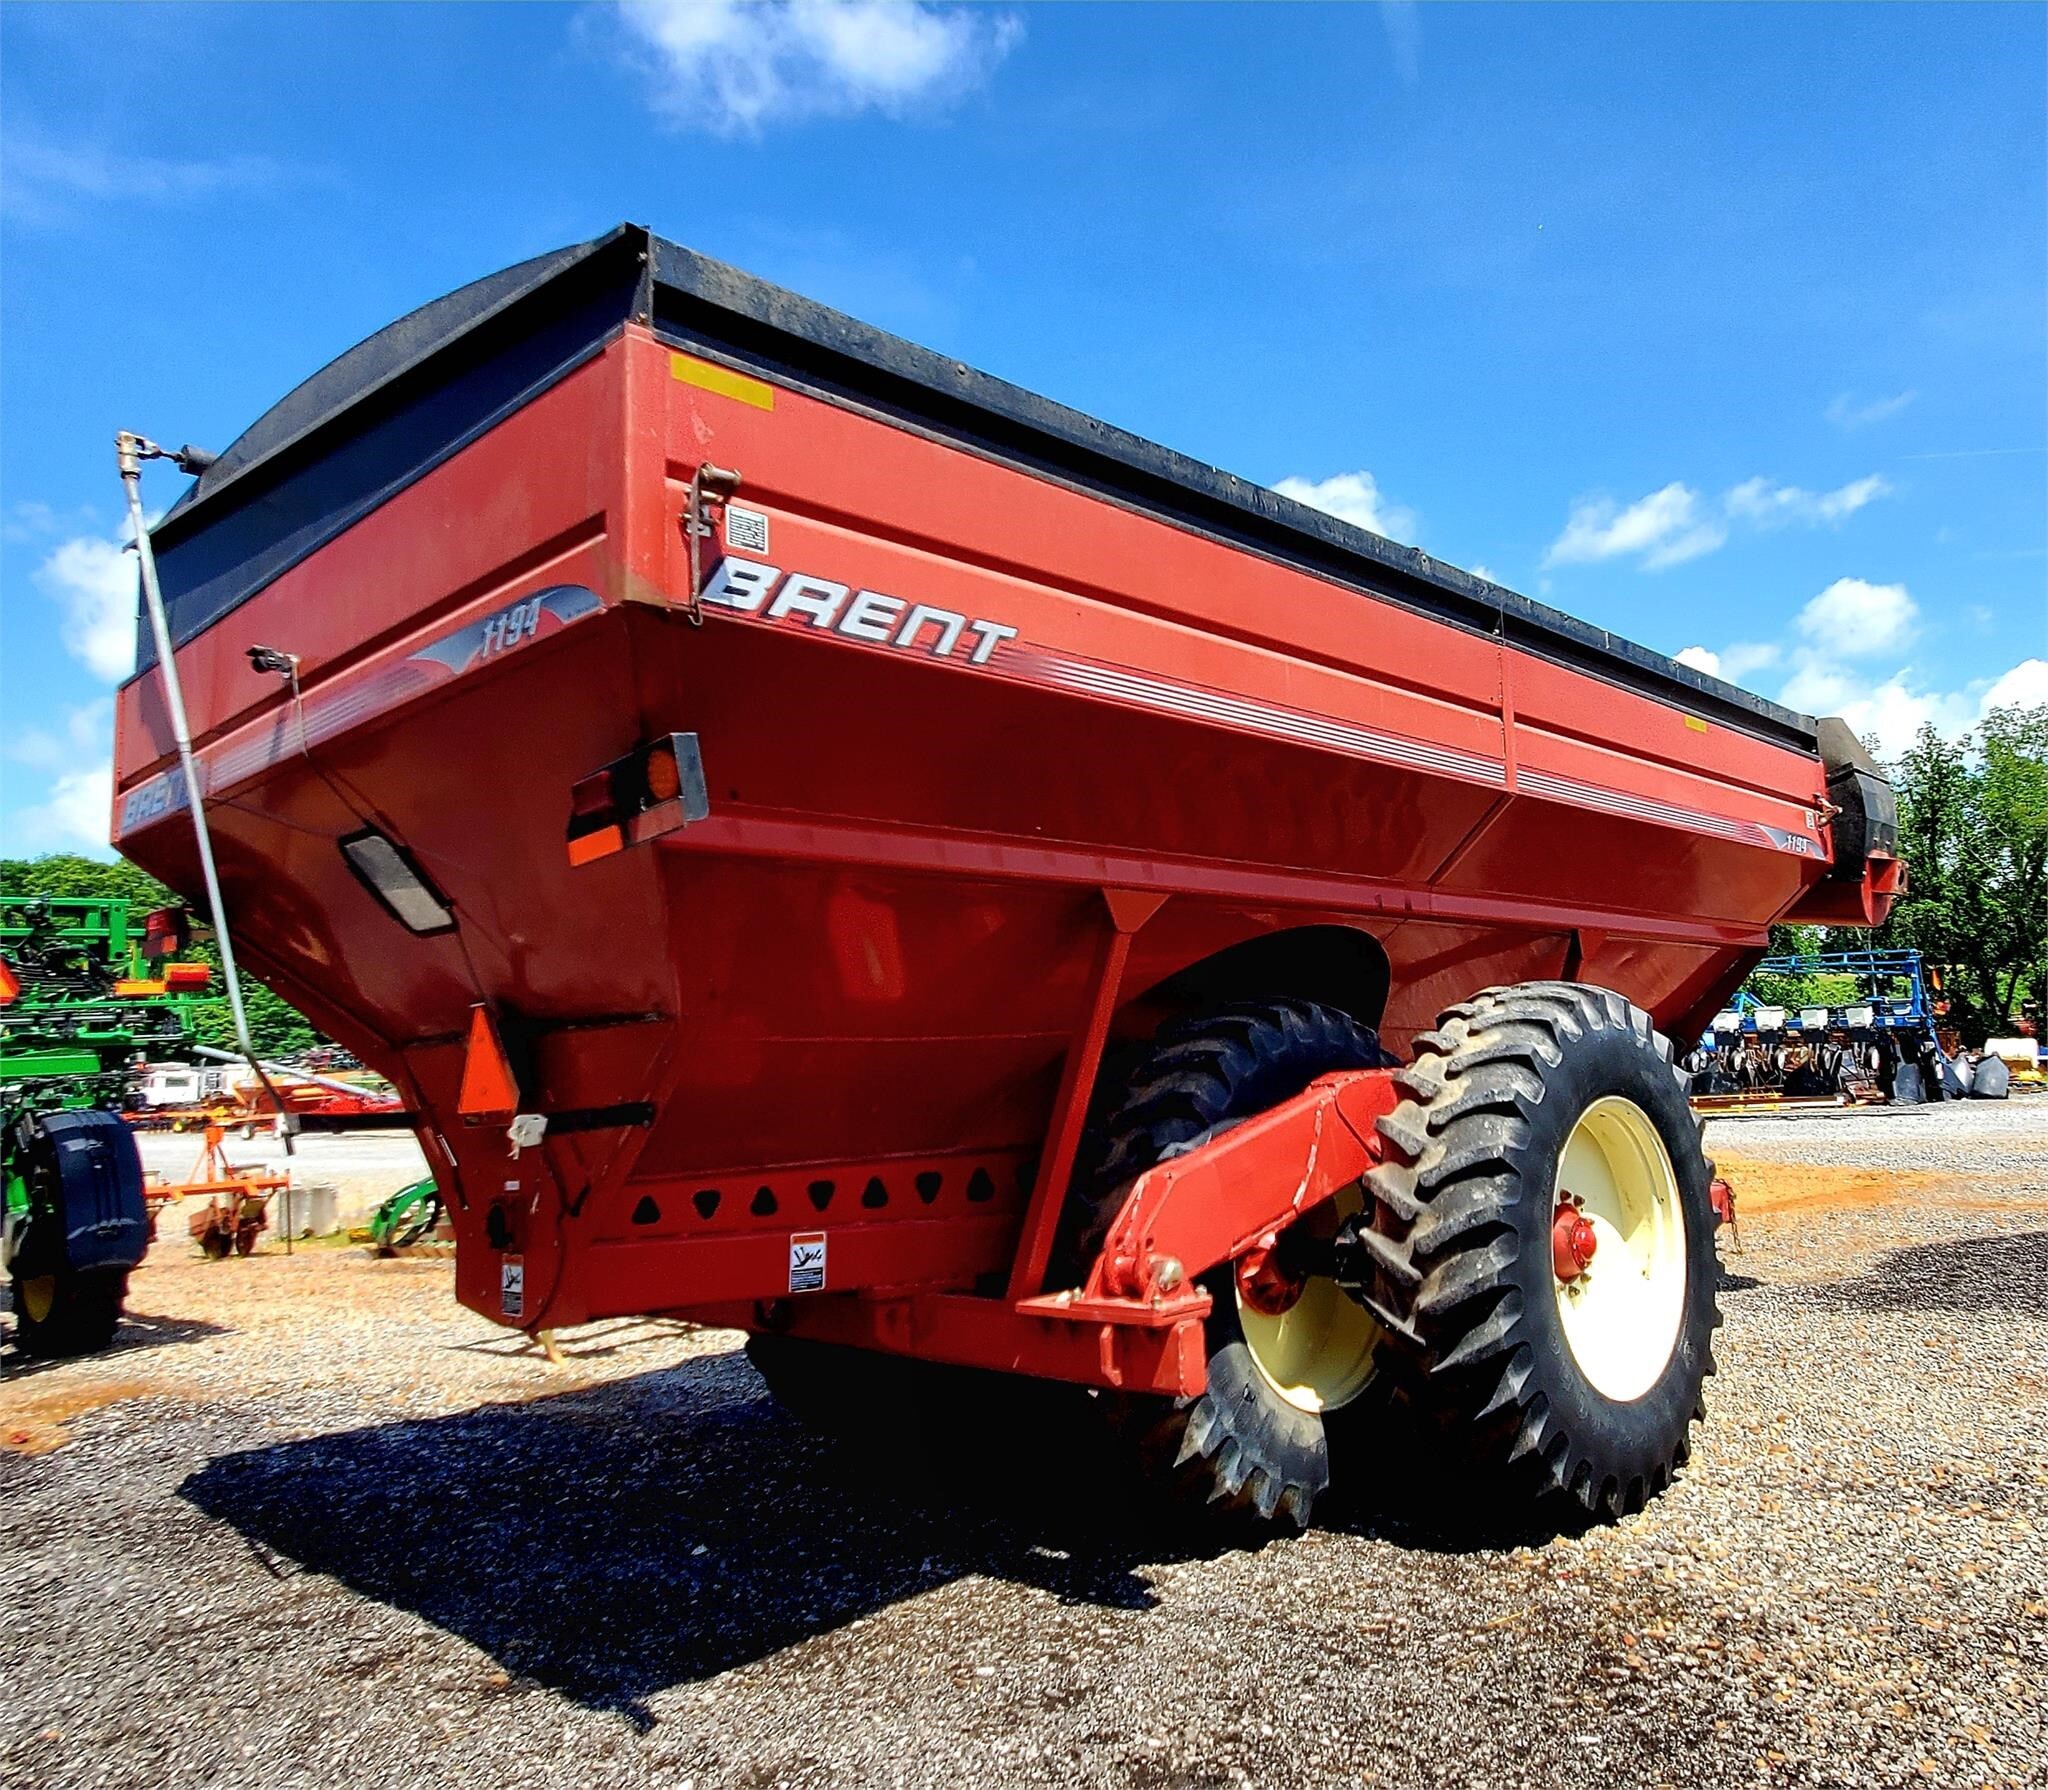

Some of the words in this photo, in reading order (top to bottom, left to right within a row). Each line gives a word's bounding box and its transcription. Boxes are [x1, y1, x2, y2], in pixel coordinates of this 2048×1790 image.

[482, 598, 541, 657] 1194
[701, 554, 1019, 664] BRENT
[1786, 834, 1808, 854] 1194
